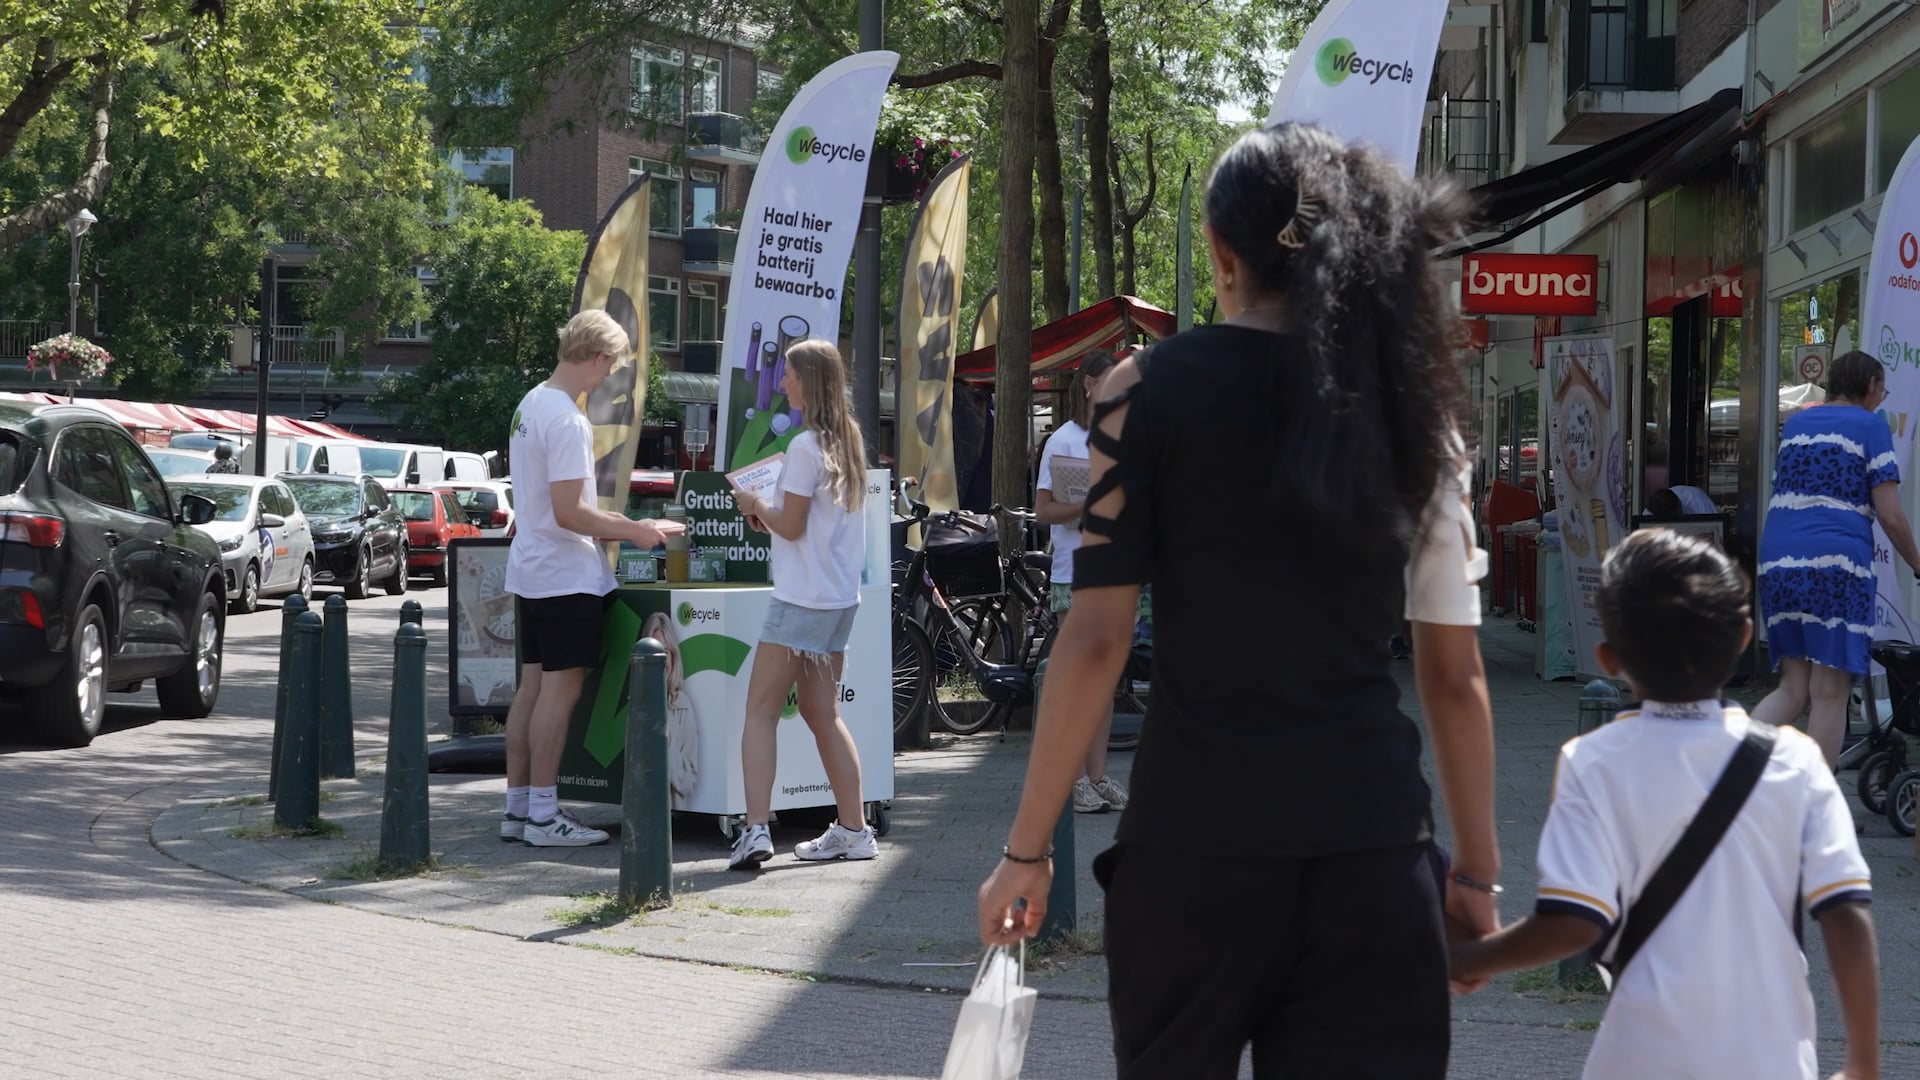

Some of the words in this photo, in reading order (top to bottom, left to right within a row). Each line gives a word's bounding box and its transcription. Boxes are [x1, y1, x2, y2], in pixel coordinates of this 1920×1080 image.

[764, 206, 799, 227] Haal
[801, 212, 832, 232] hier
[759, 228, 774, 248] je
[778, 235, 823, 254] gratis
[758, 250, 815, 279] batterij
[755, 272, 837, 300] bewaarbo
[1468, 260, 1591, 297] bruna
[684, 489, 733, 510] Gratis
[687, 515, 744, 541] Batterij
